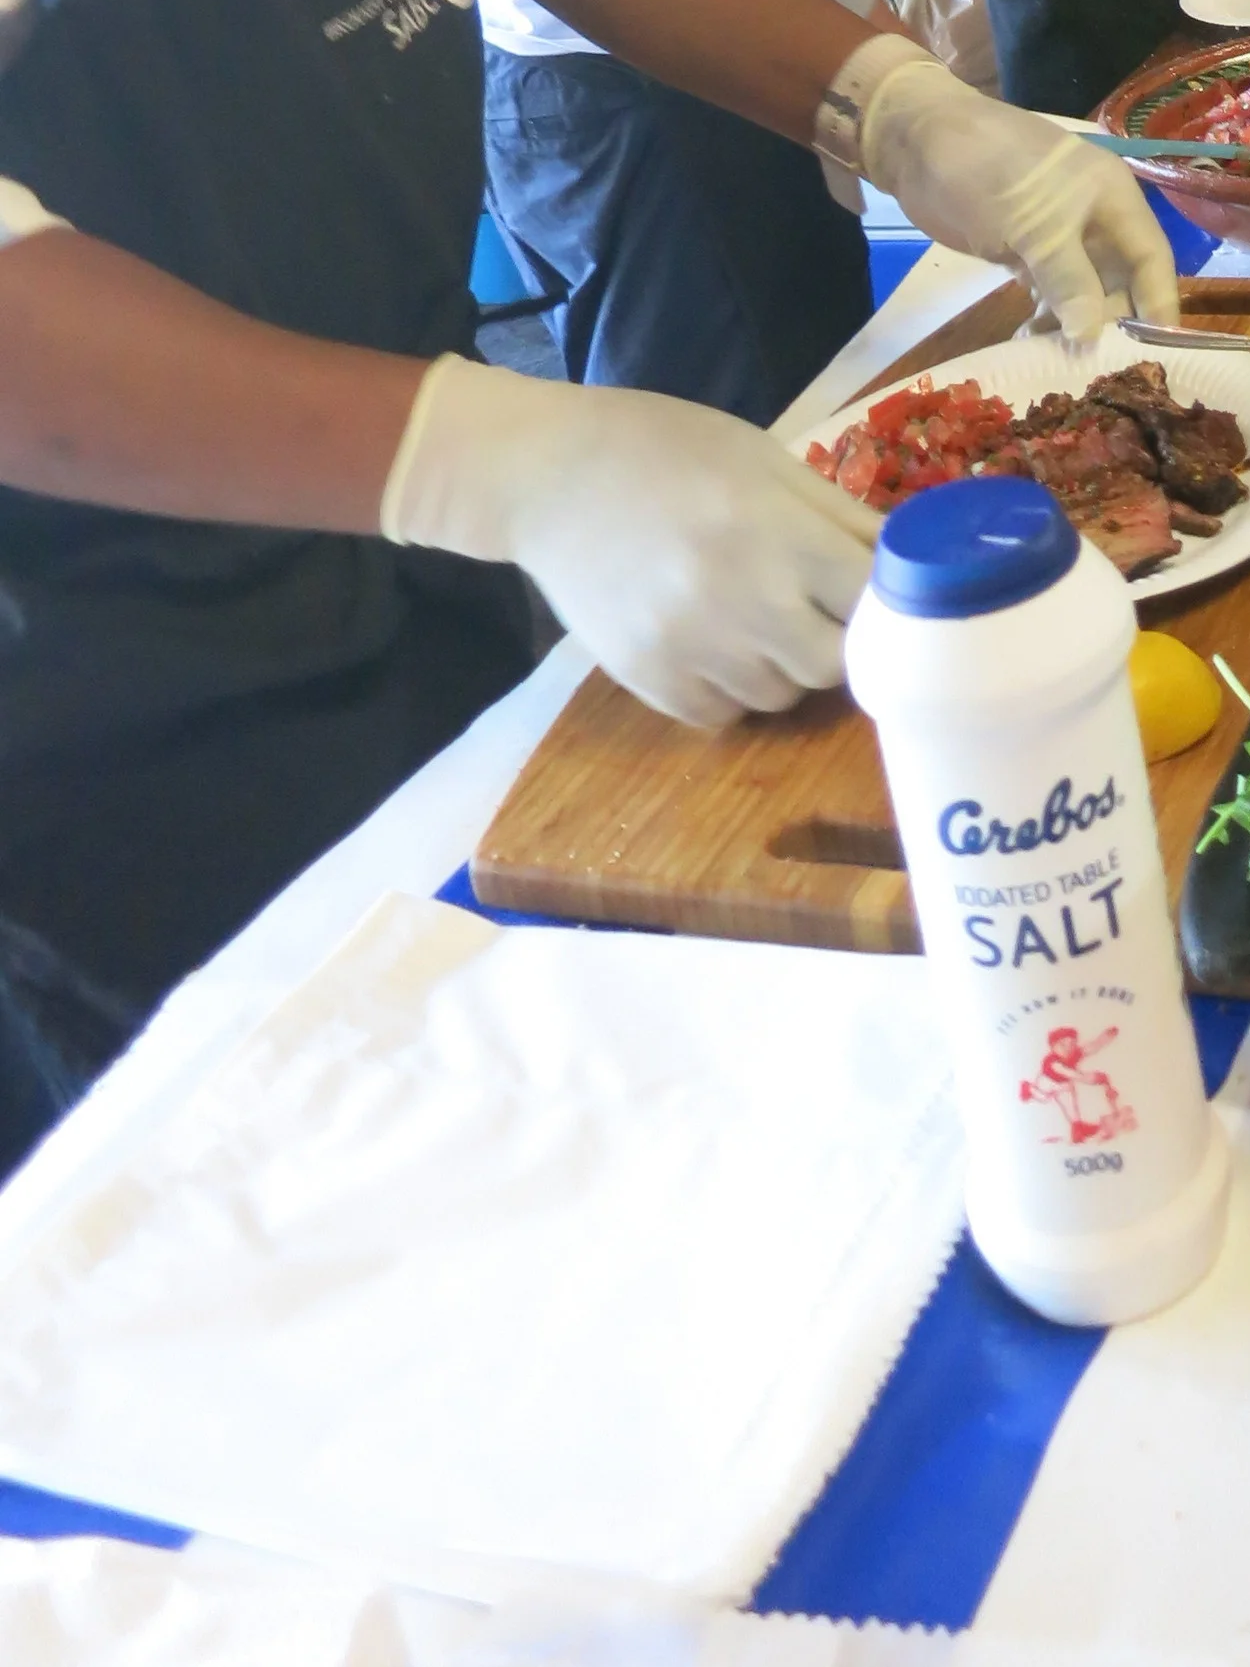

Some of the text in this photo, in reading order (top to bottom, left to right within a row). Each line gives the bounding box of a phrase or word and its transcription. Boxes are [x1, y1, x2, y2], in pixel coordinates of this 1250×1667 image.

[938, 775, 1116, 856] Cerebos
[1056, 846, 1121, 894] TABLE
[963, 876, 1124, 969] SALT
